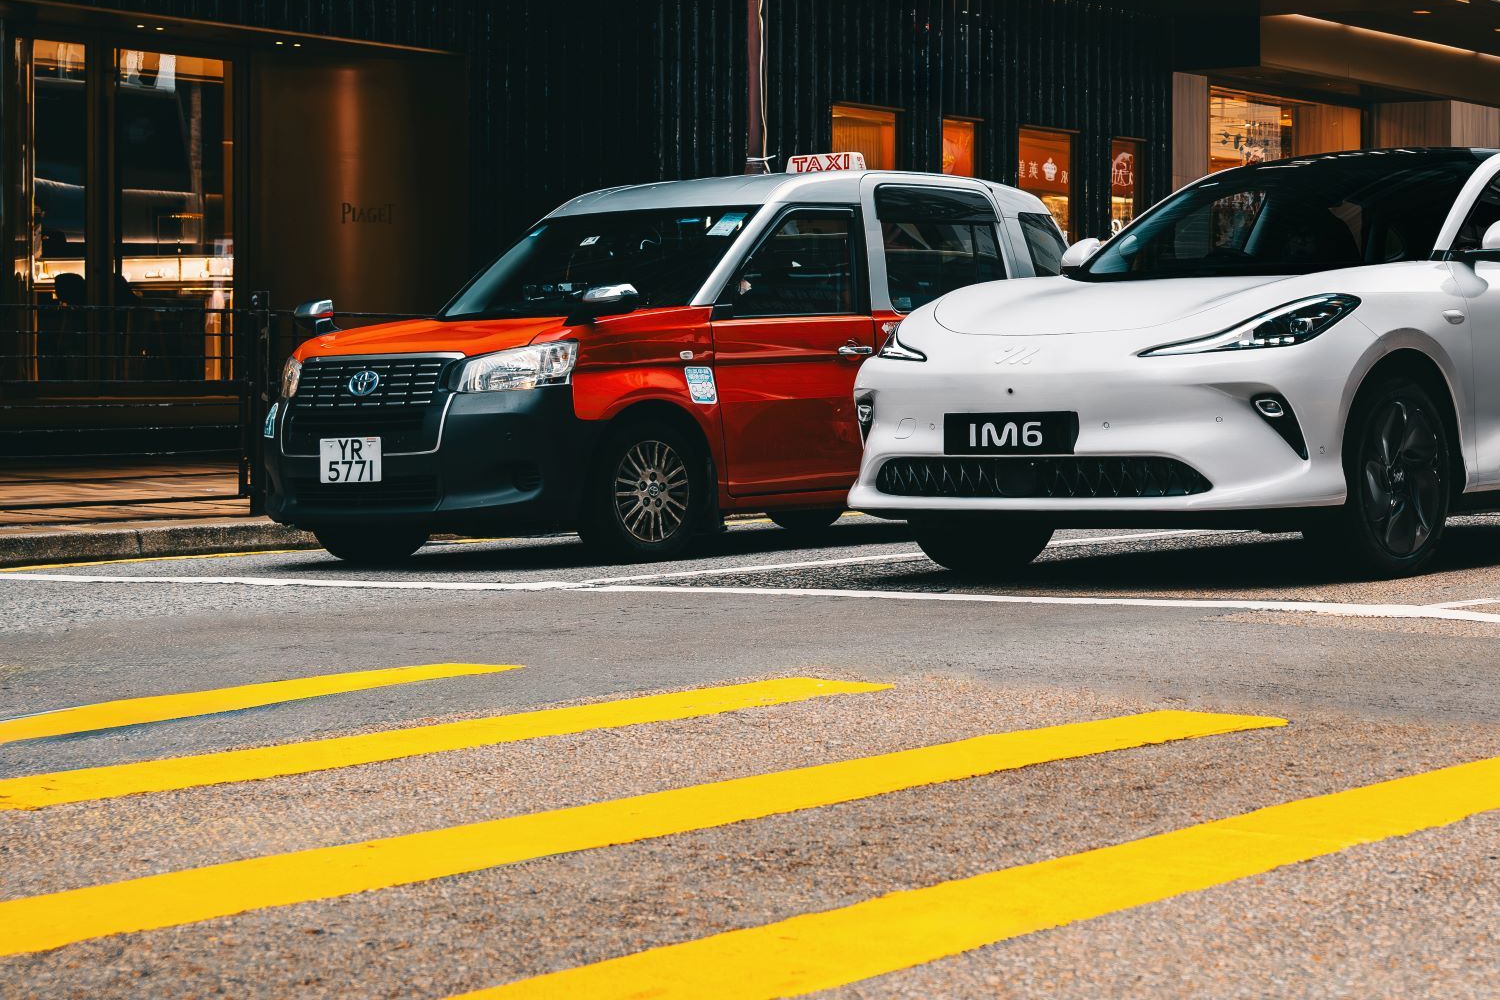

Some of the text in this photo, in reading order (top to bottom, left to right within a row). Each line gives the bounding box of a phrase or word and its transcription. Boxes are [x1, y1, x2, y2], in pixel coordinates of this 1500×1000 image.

[792, 153, 850, 172] TAXI
[341, 202, 397, 225] PIAGET
[969, 421, 1044, 447] IM6
[337, 438, 363, 461] YR
[328, 459, 374, 482] 5771
